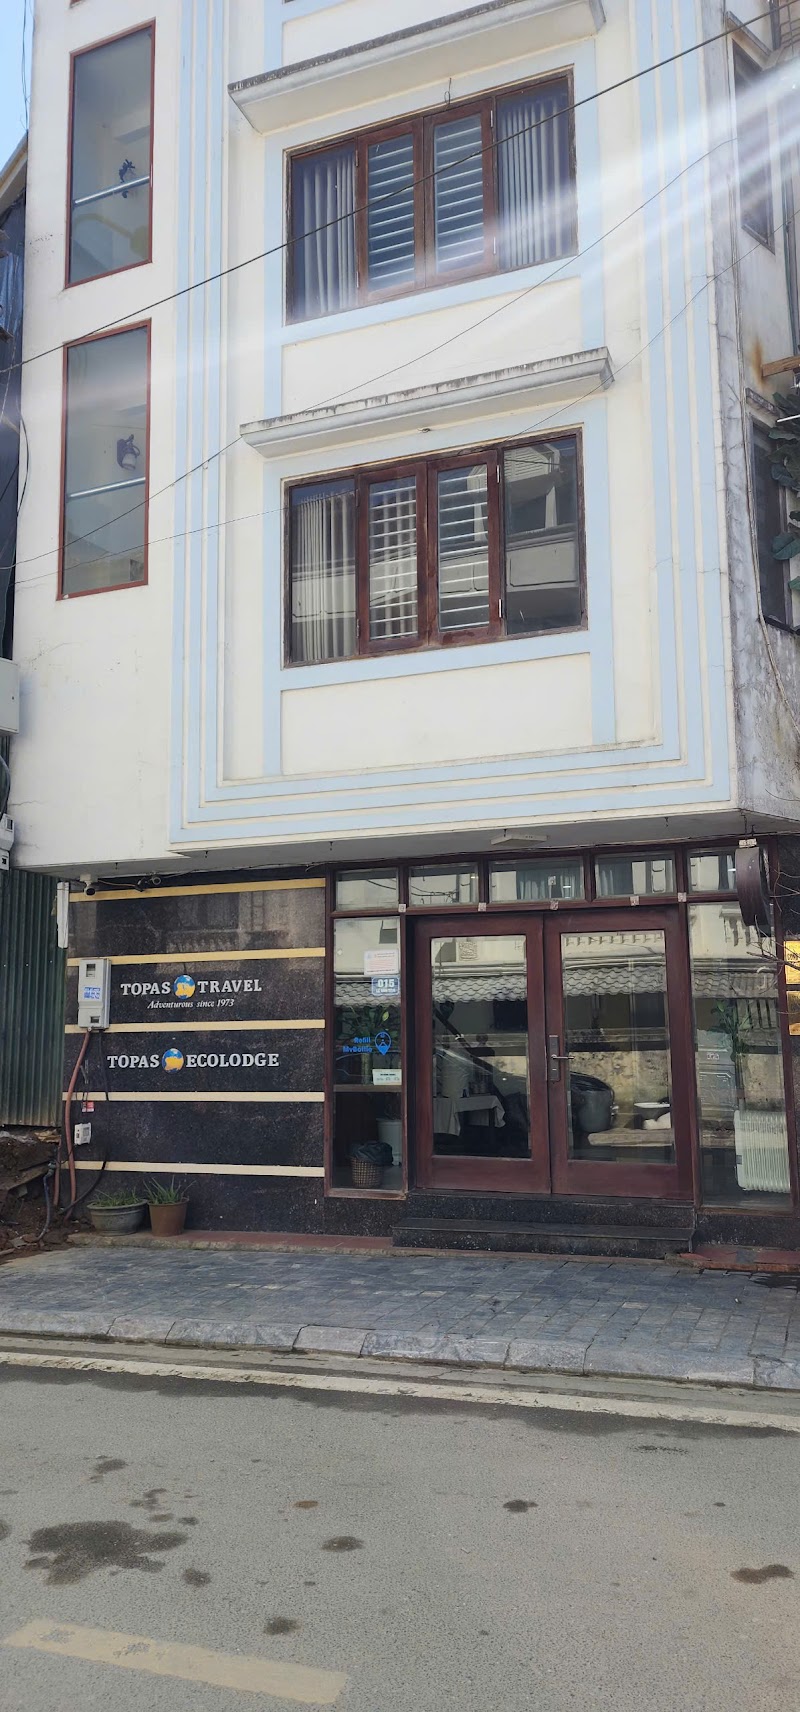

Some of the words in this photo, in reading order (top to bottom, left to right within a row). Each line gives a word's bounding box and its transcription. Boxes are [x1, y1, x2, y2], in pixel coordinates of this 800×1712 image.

[120, 981, 171, 996] TOPAS
[197, 979, 262, 993] TRAVEL
[377, 979, 395, 988] 015
[147, 1000, 194, 1009] Adventurous
[196, 1000, 215, 1008] since
[217, 998, 235, 1007] 1973
[107, 1054, 160, 1068] TOPAS
[186, 1053, 280, 1068] ECOLODGE
